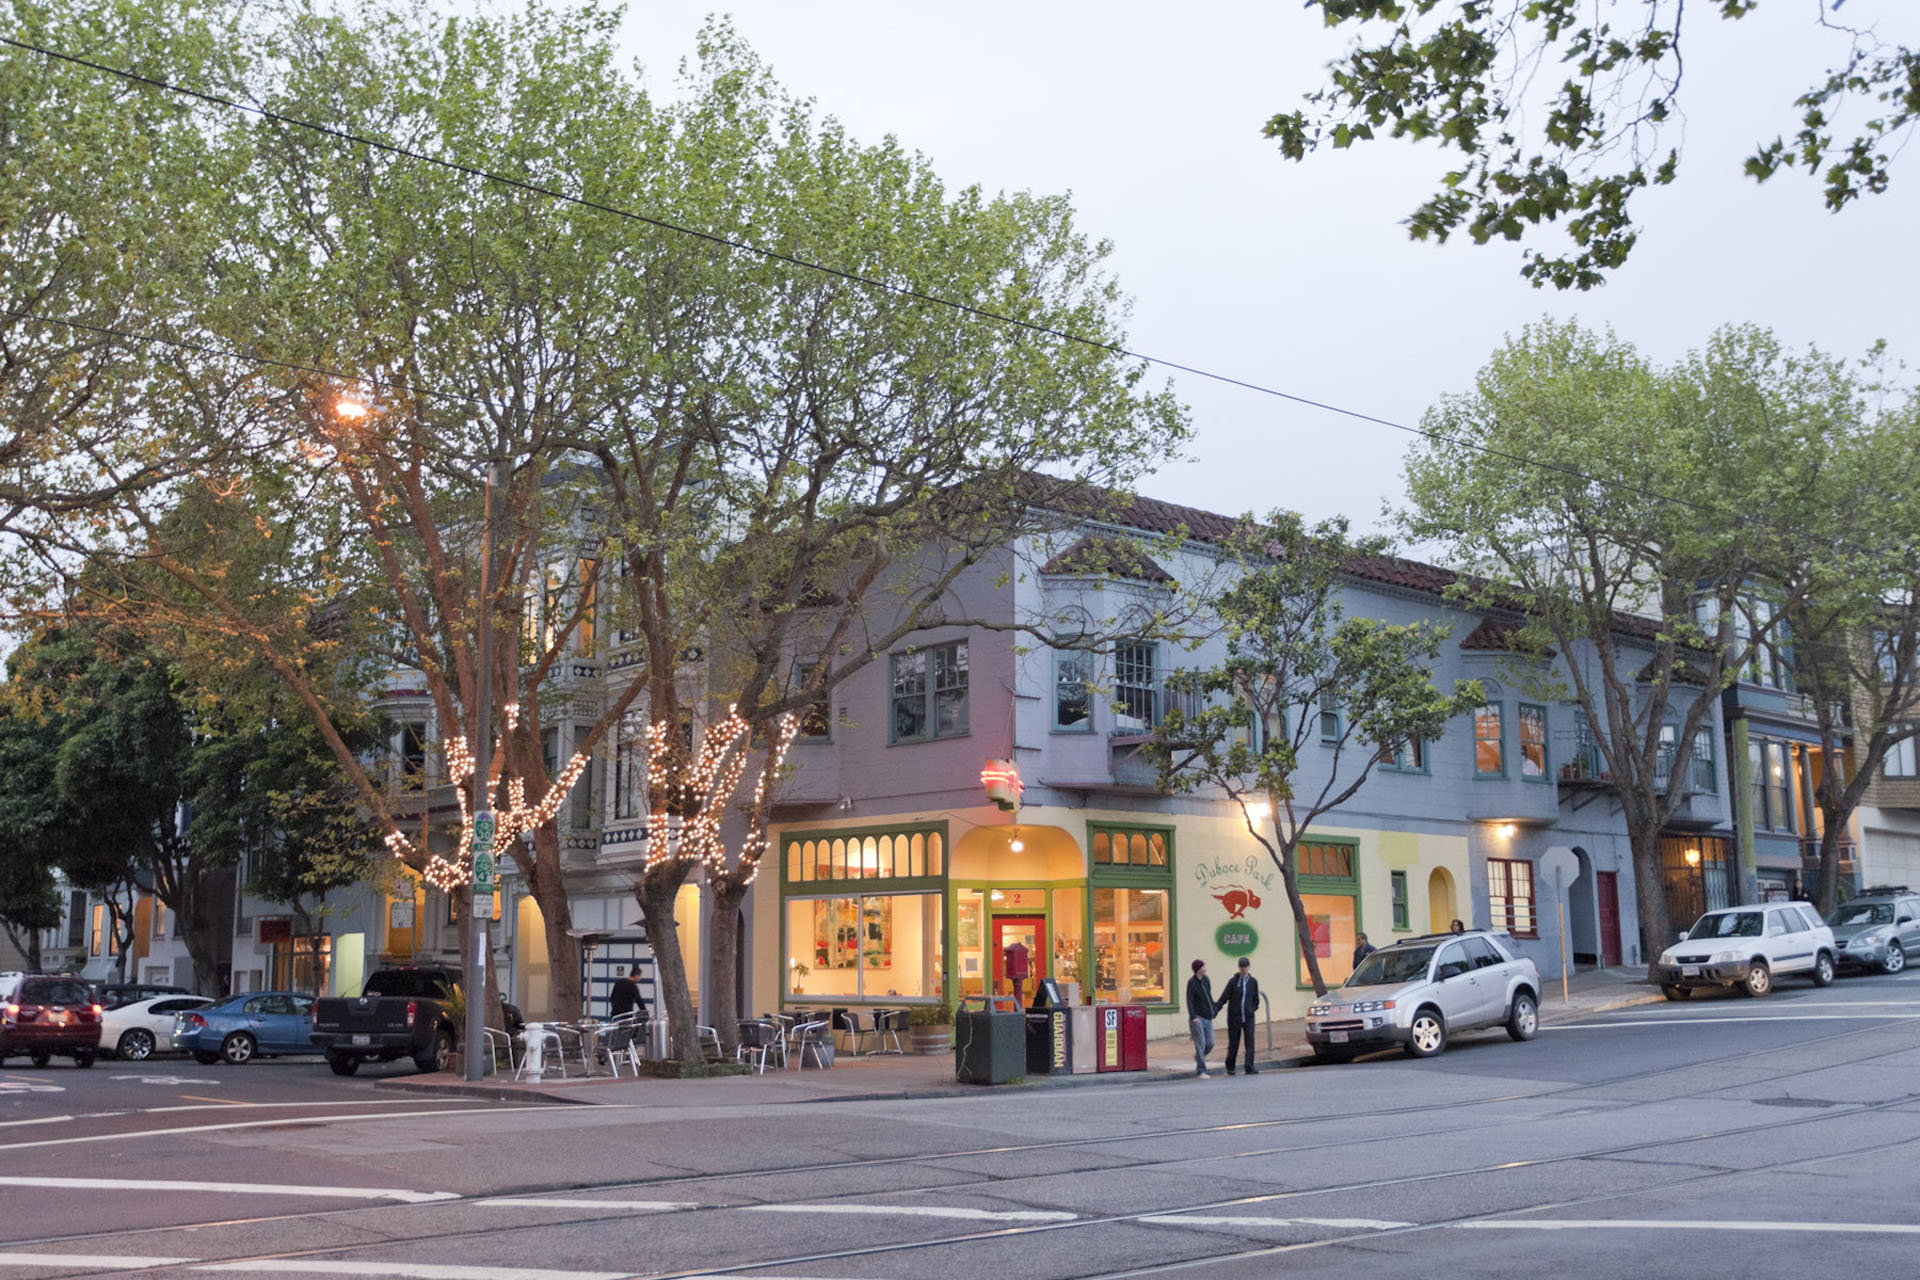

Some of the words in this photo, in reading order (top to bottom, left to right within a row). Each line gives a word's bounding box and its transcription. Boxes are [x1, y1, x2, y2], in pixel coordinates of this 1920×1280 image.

[479, 831, 491, 839] 30
[1195, 856, 1240, 888] Duboce
[1244, 855, 1274, 891] Park
[1014, 893, 1021, 903] 2
[1223, 934, 1250, 945] CAFE
[1106, 1011, 1116, 1026] SF
[1053, 1011, 1064, 1068] GUARDIAN
